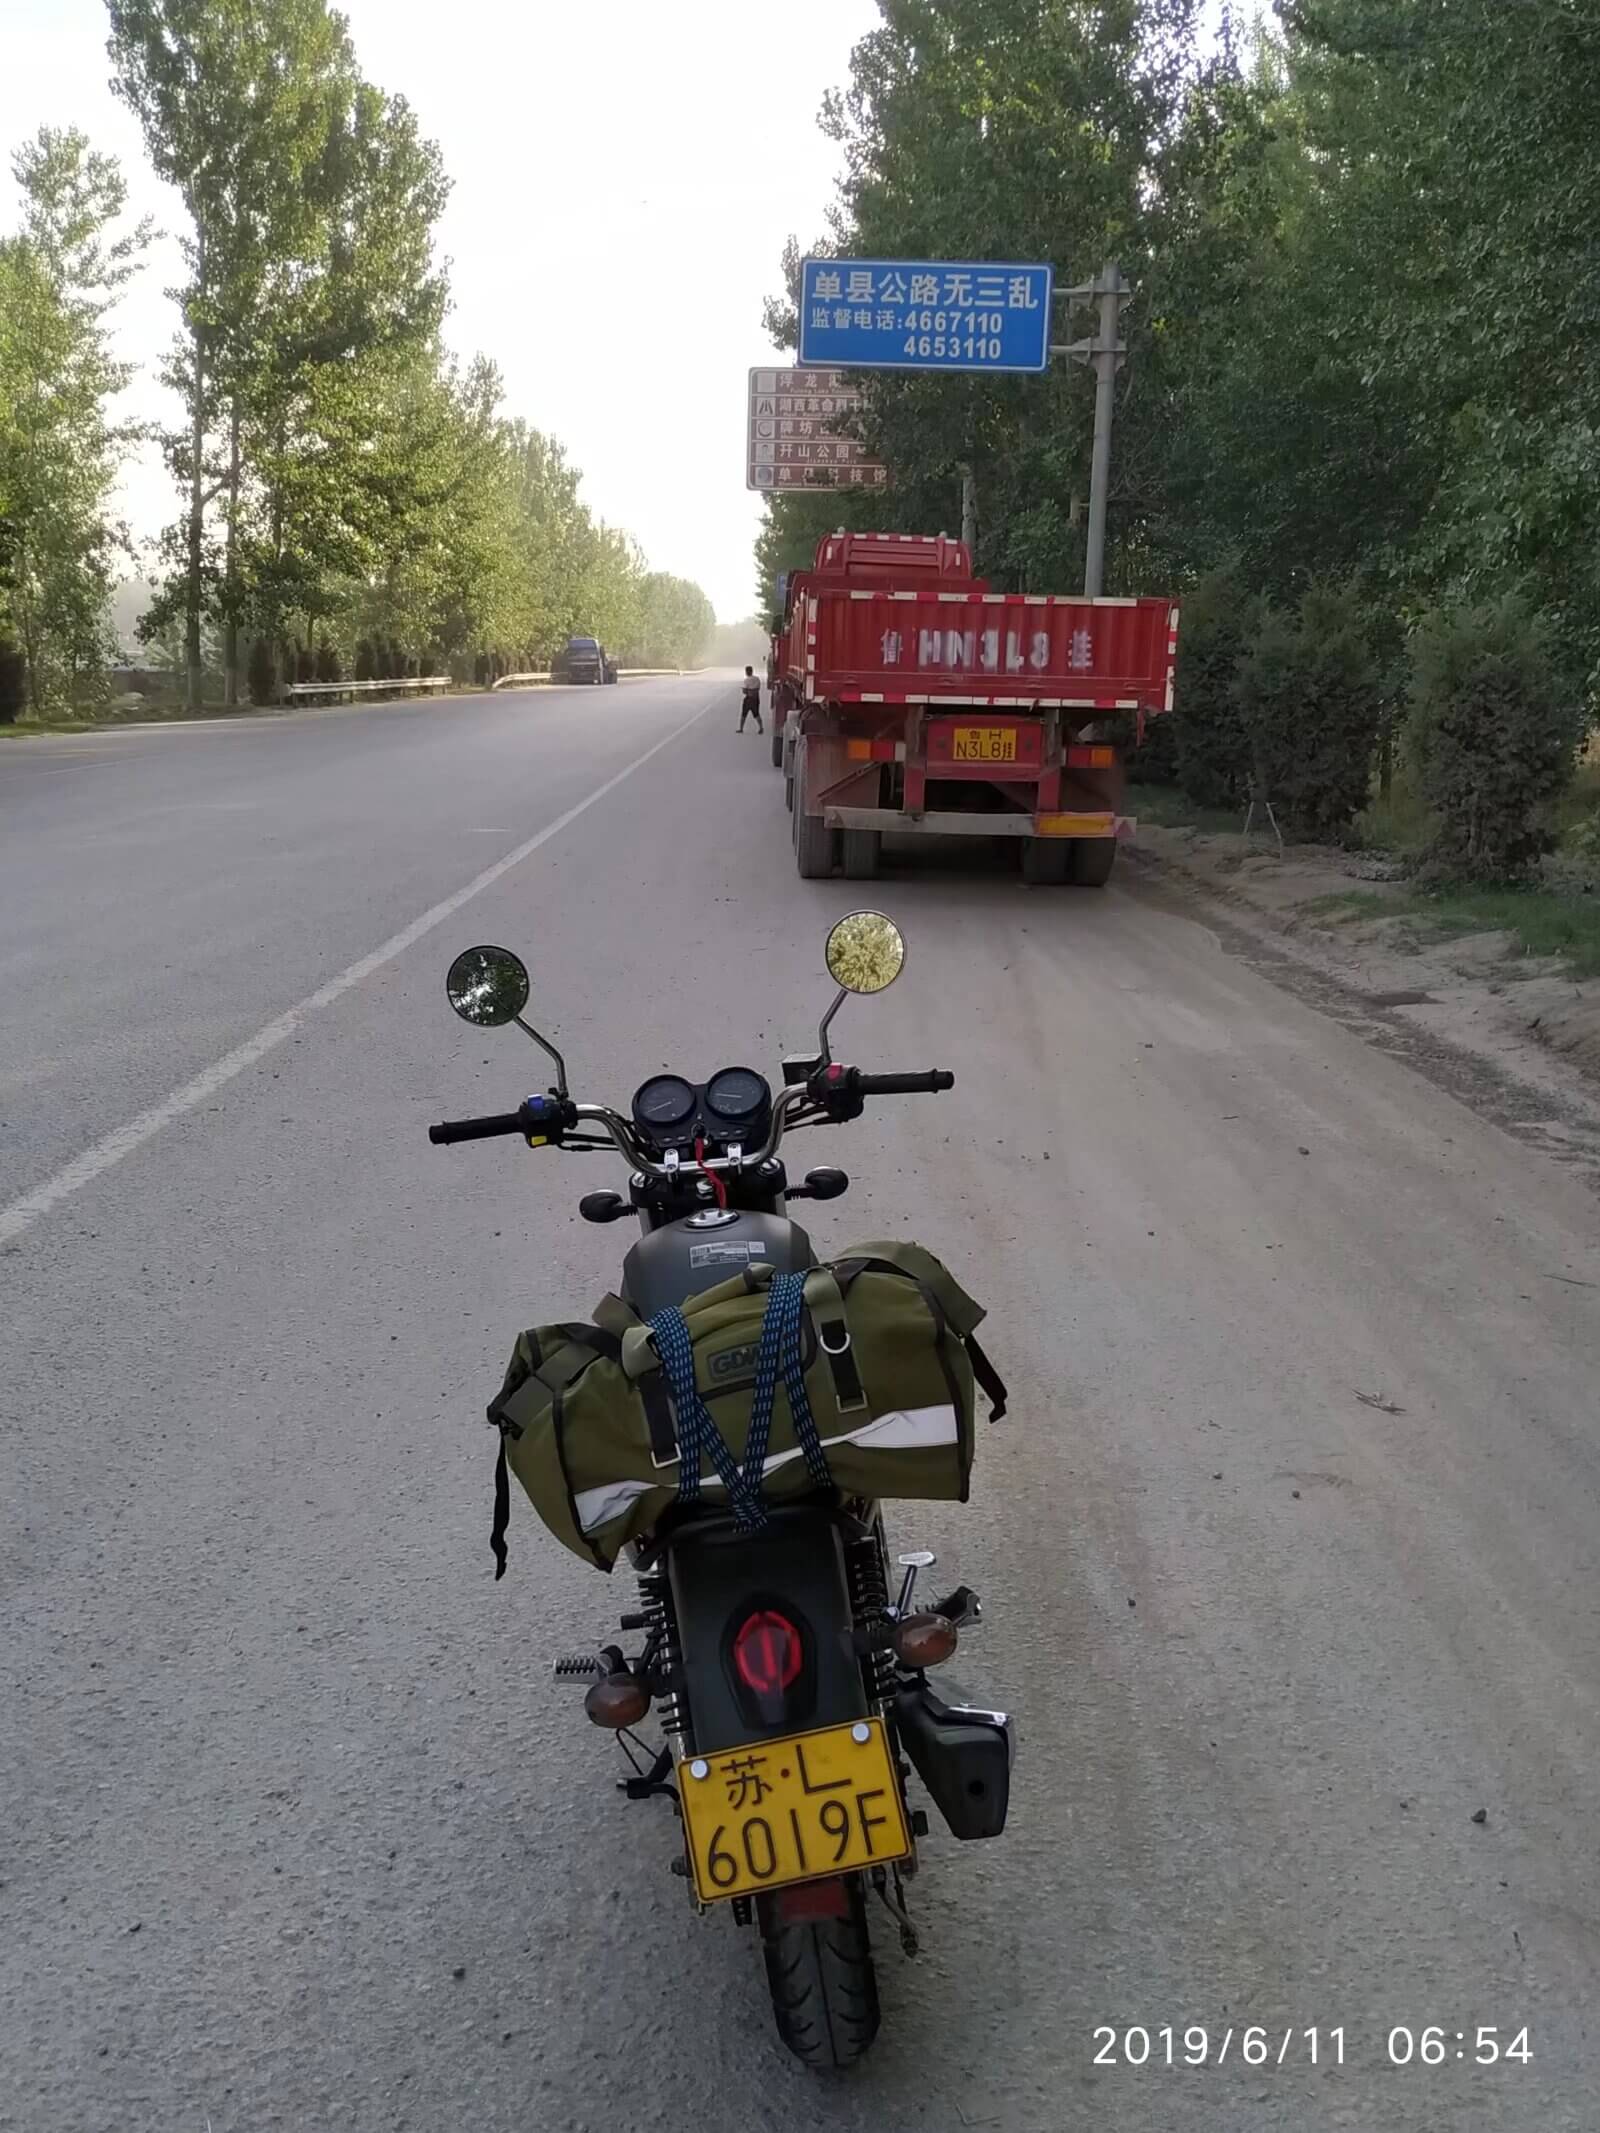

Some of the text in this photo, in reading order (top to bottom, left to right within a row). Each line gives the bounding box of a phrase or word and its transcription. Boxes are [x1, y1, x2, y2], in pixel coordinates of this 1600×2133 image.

[811, 271, 1039, 309] 单县公路无三乱
[904, 337, 1001, 359] 4653110
[707, 1789, 887, 1888] 6019F
